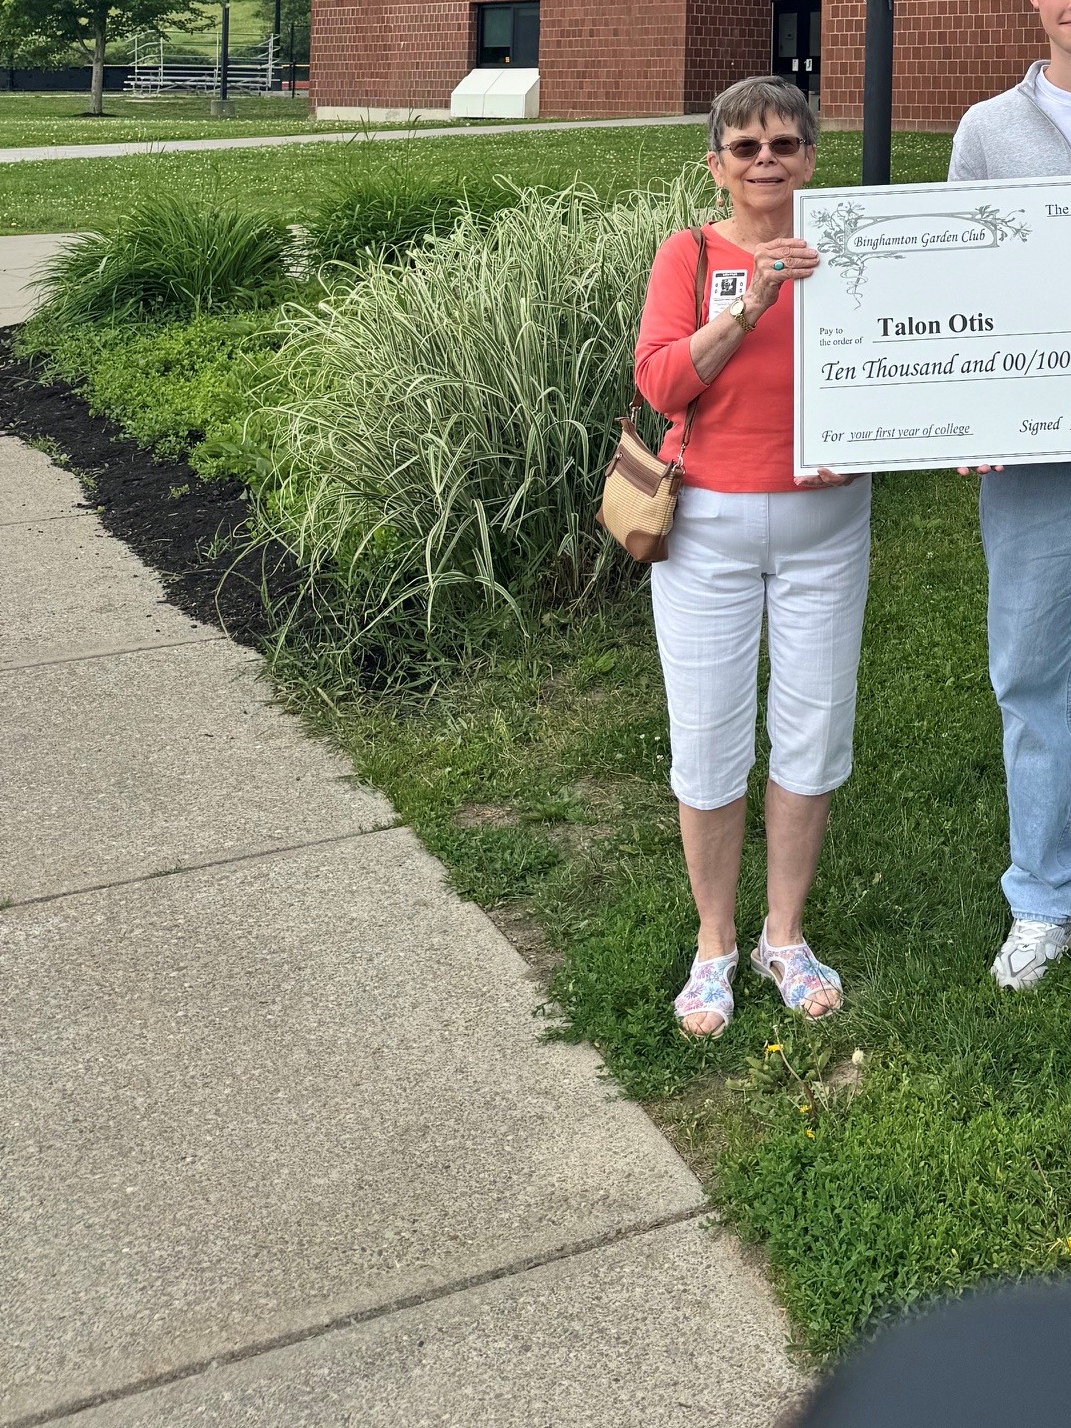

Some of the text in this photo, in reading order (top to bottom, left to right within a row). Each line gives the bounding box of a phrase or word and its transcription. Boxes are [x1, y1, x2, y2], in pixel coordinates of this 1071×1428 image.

[1045, 204, 1069, 215] The
[854, 228, 986, 250] Binghamton Garden Club
[819, 327, 833, 335] Pay
[877, 313, 994, 337] Talon Otis
[819, 336, 863, 346] the order of
[821, 349, 1071, 381] Ten Thousand and 00/100
[821, 423, 971, 443] For your first year of college
[1019, 416, 1063, 436] Signed
